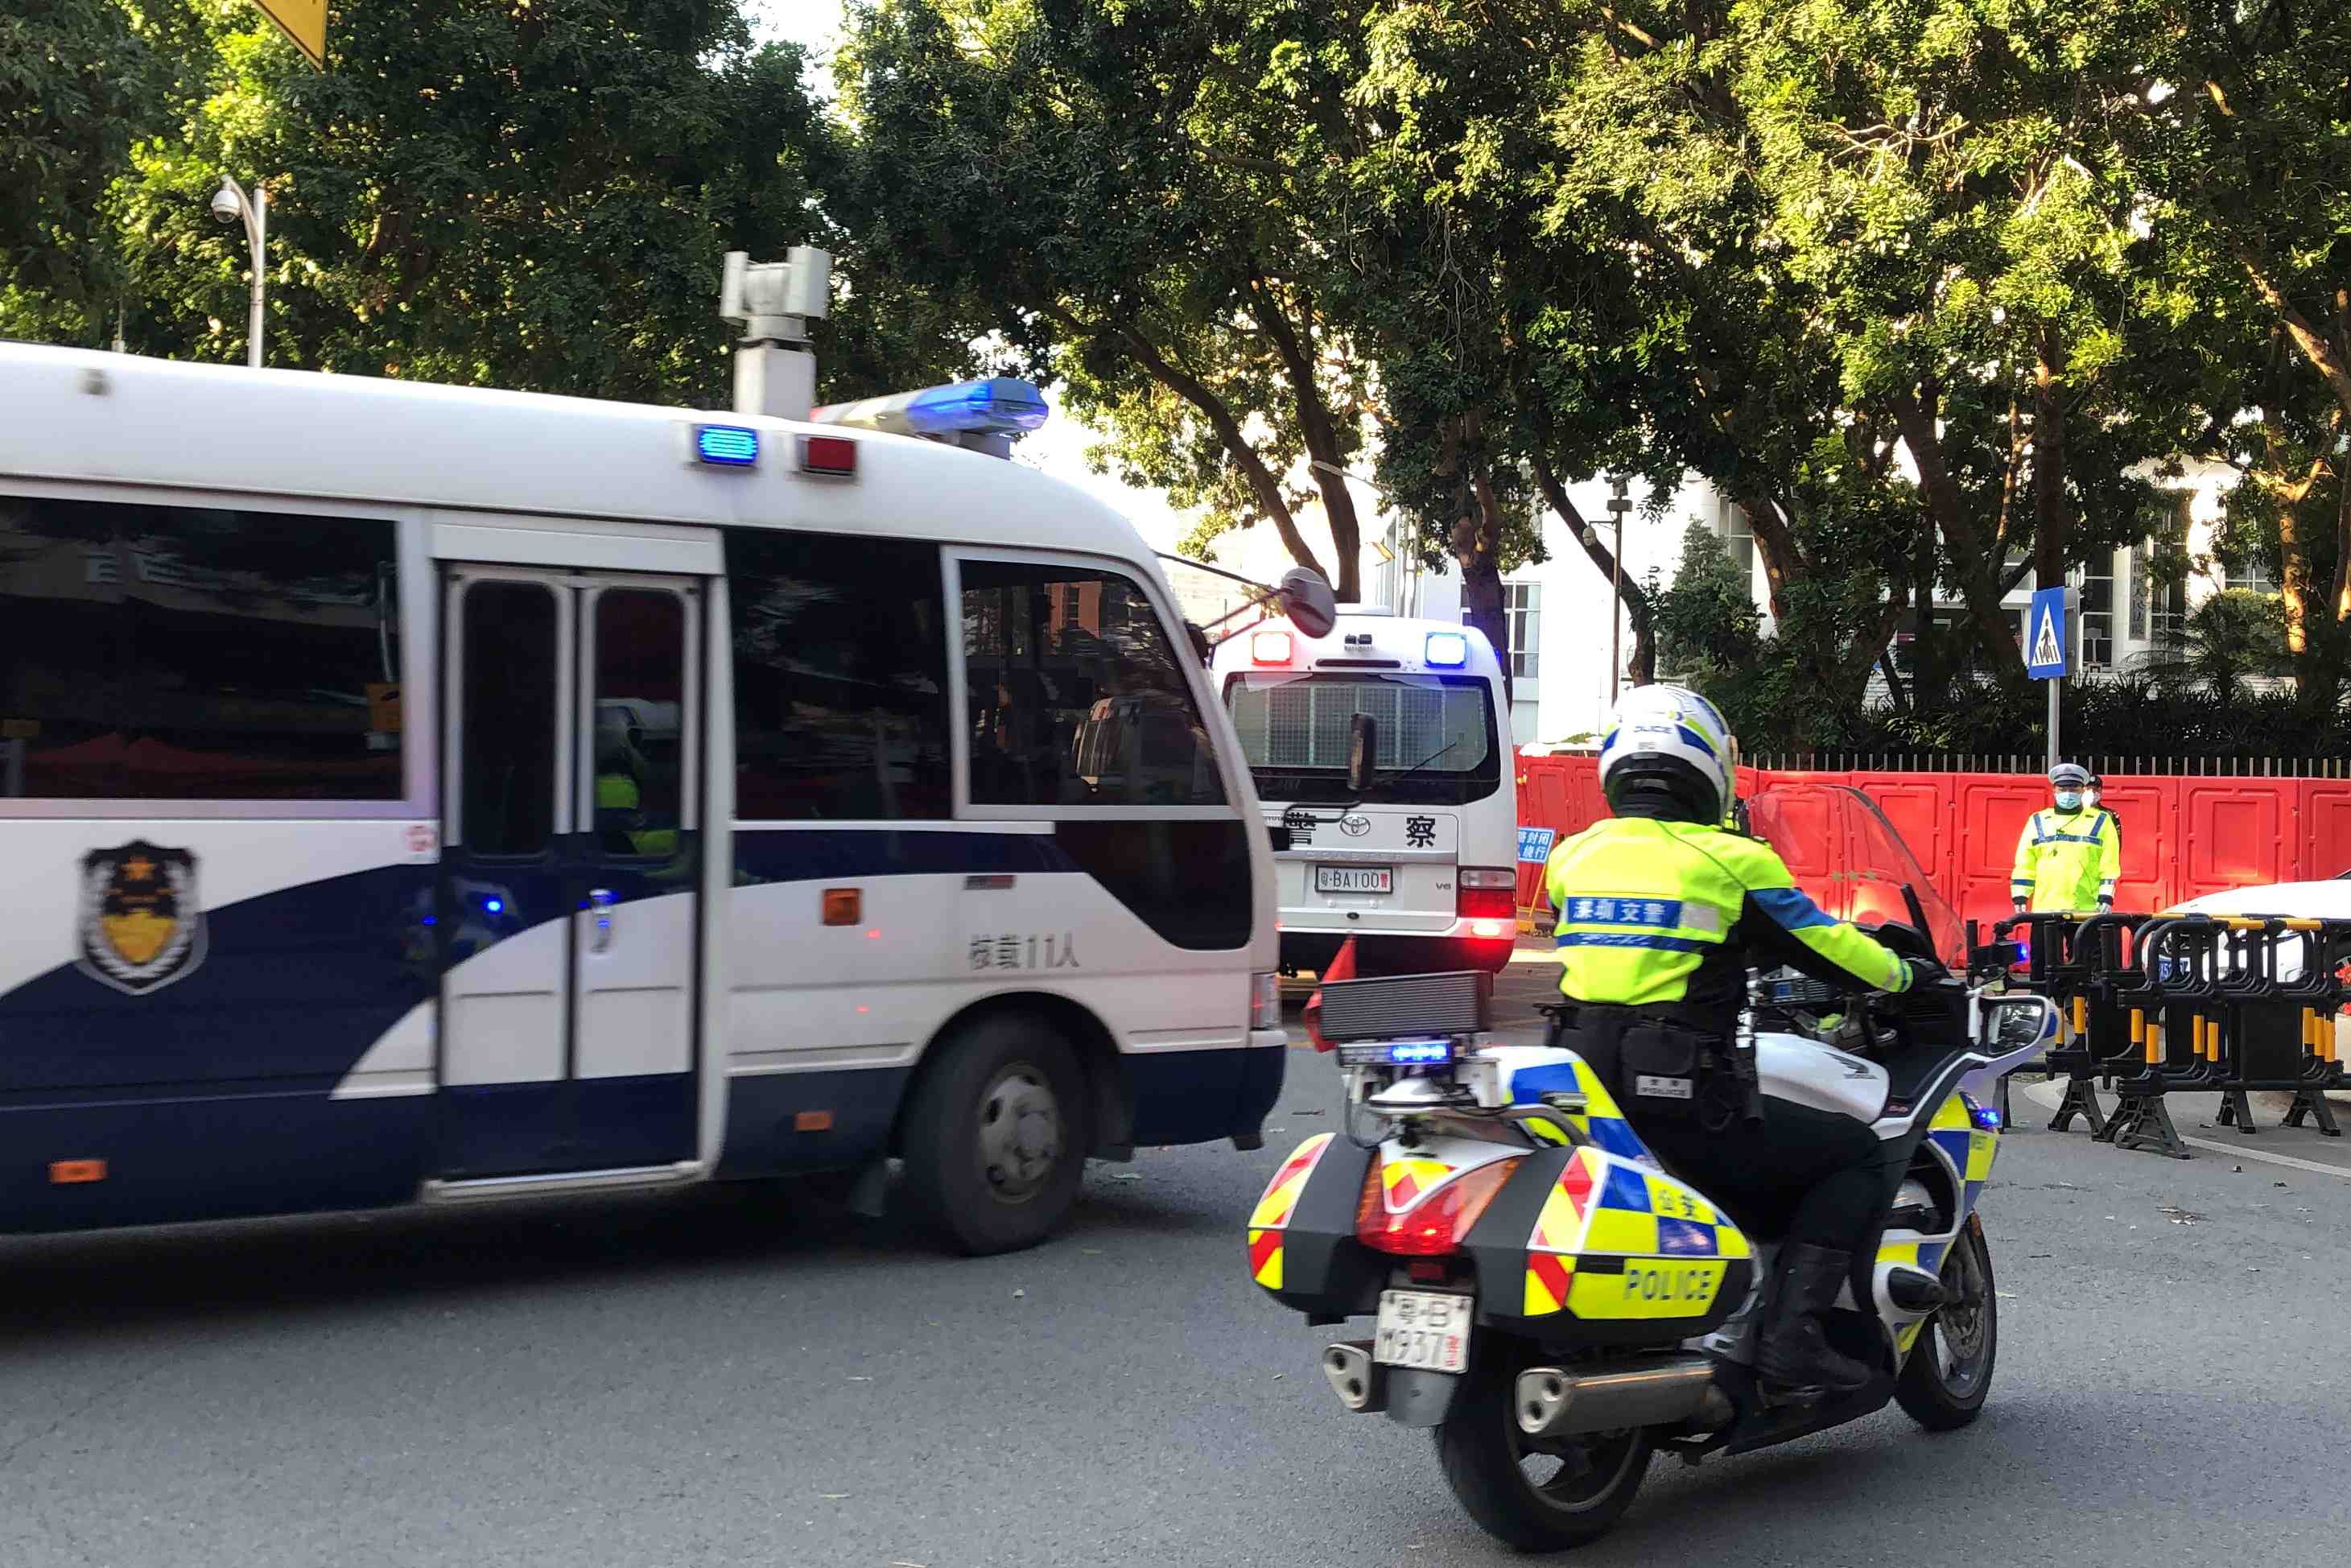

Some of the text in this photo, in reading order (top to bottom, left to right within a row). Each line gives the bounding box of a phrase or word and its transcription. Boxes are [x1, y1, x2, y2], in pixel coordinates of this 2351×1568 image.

[1287, 812, 1436, 848] 警 察
[1573, 898, 1665, 923] 深圳交警
[1659, 1189, 1695, 1216] 公安
[1624, 1269, 1712, 1301] POLICE
